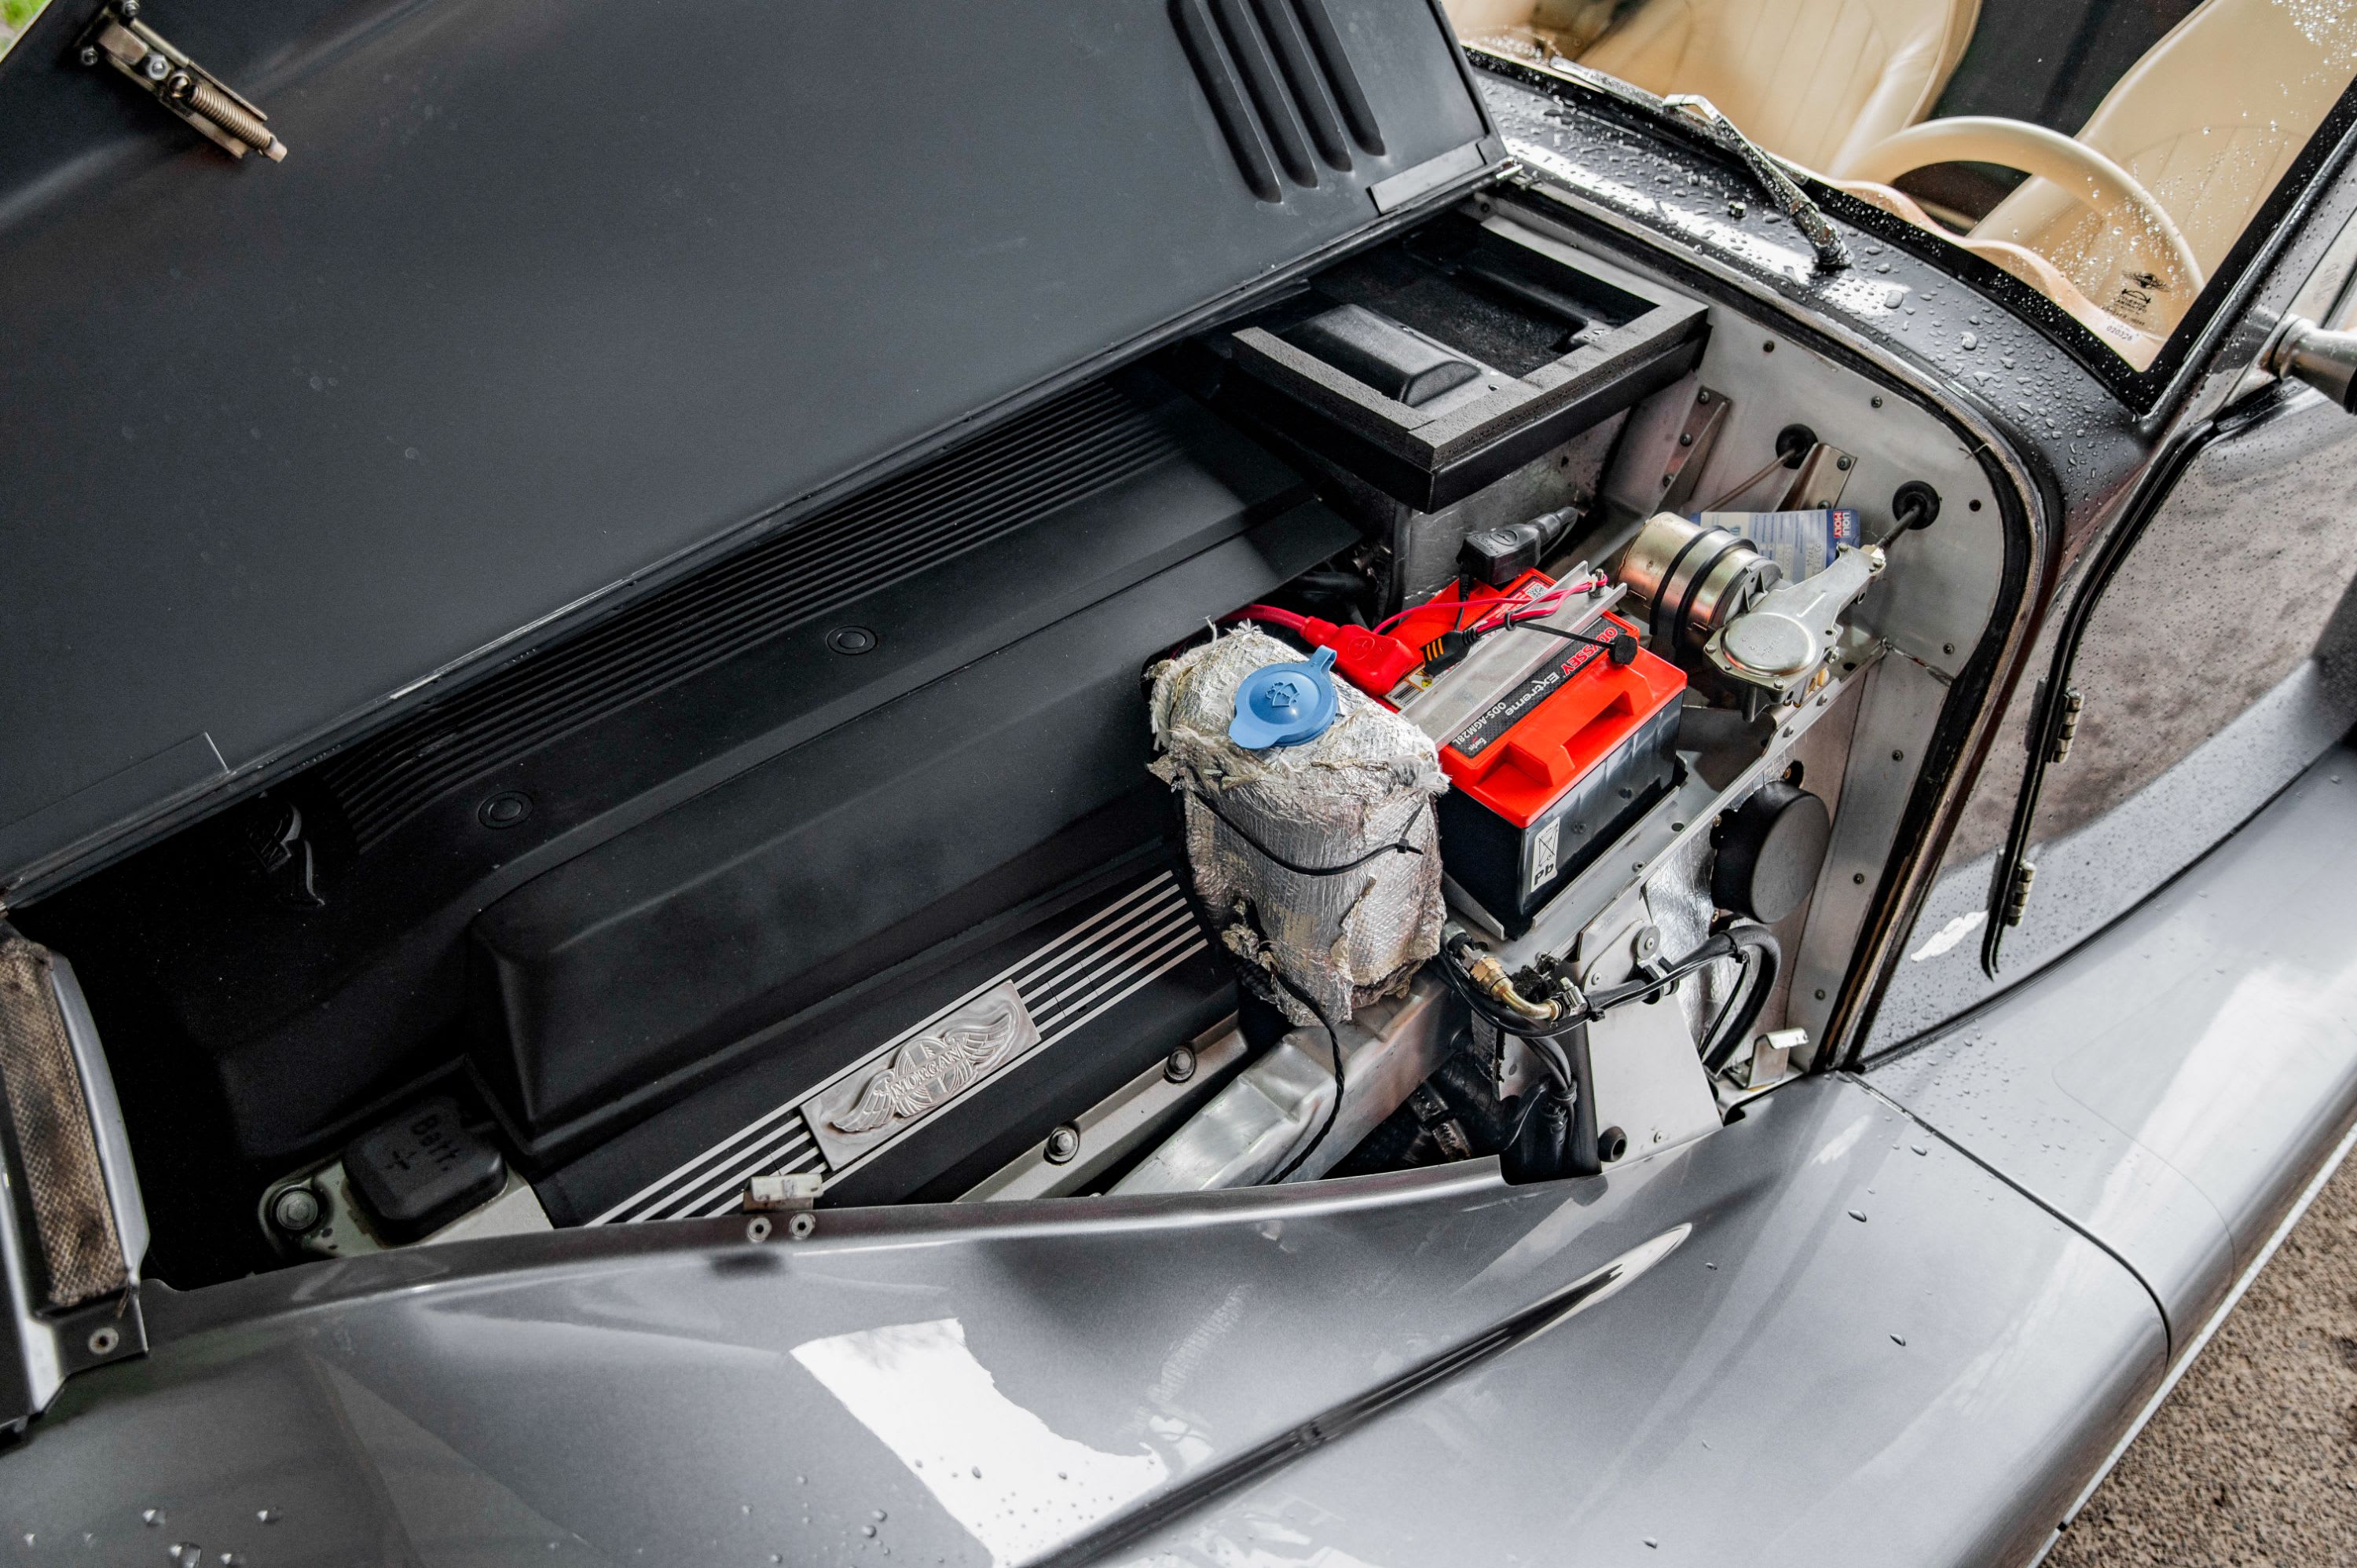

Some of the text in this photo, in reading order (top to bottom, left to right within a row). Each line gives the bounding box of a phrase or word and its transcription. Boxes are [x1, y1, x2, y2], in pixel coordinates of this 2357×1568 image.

[1842, 512, 1851, 537] LIQUI
[1505, 627, 1618, 716] ODYSSEY Extreme
[1452, 702, 1507, 746] ODS-AGM28L
[1534, 863, 1554, 886] Pb
[893, 1046, 964, 1097] MORGAN
